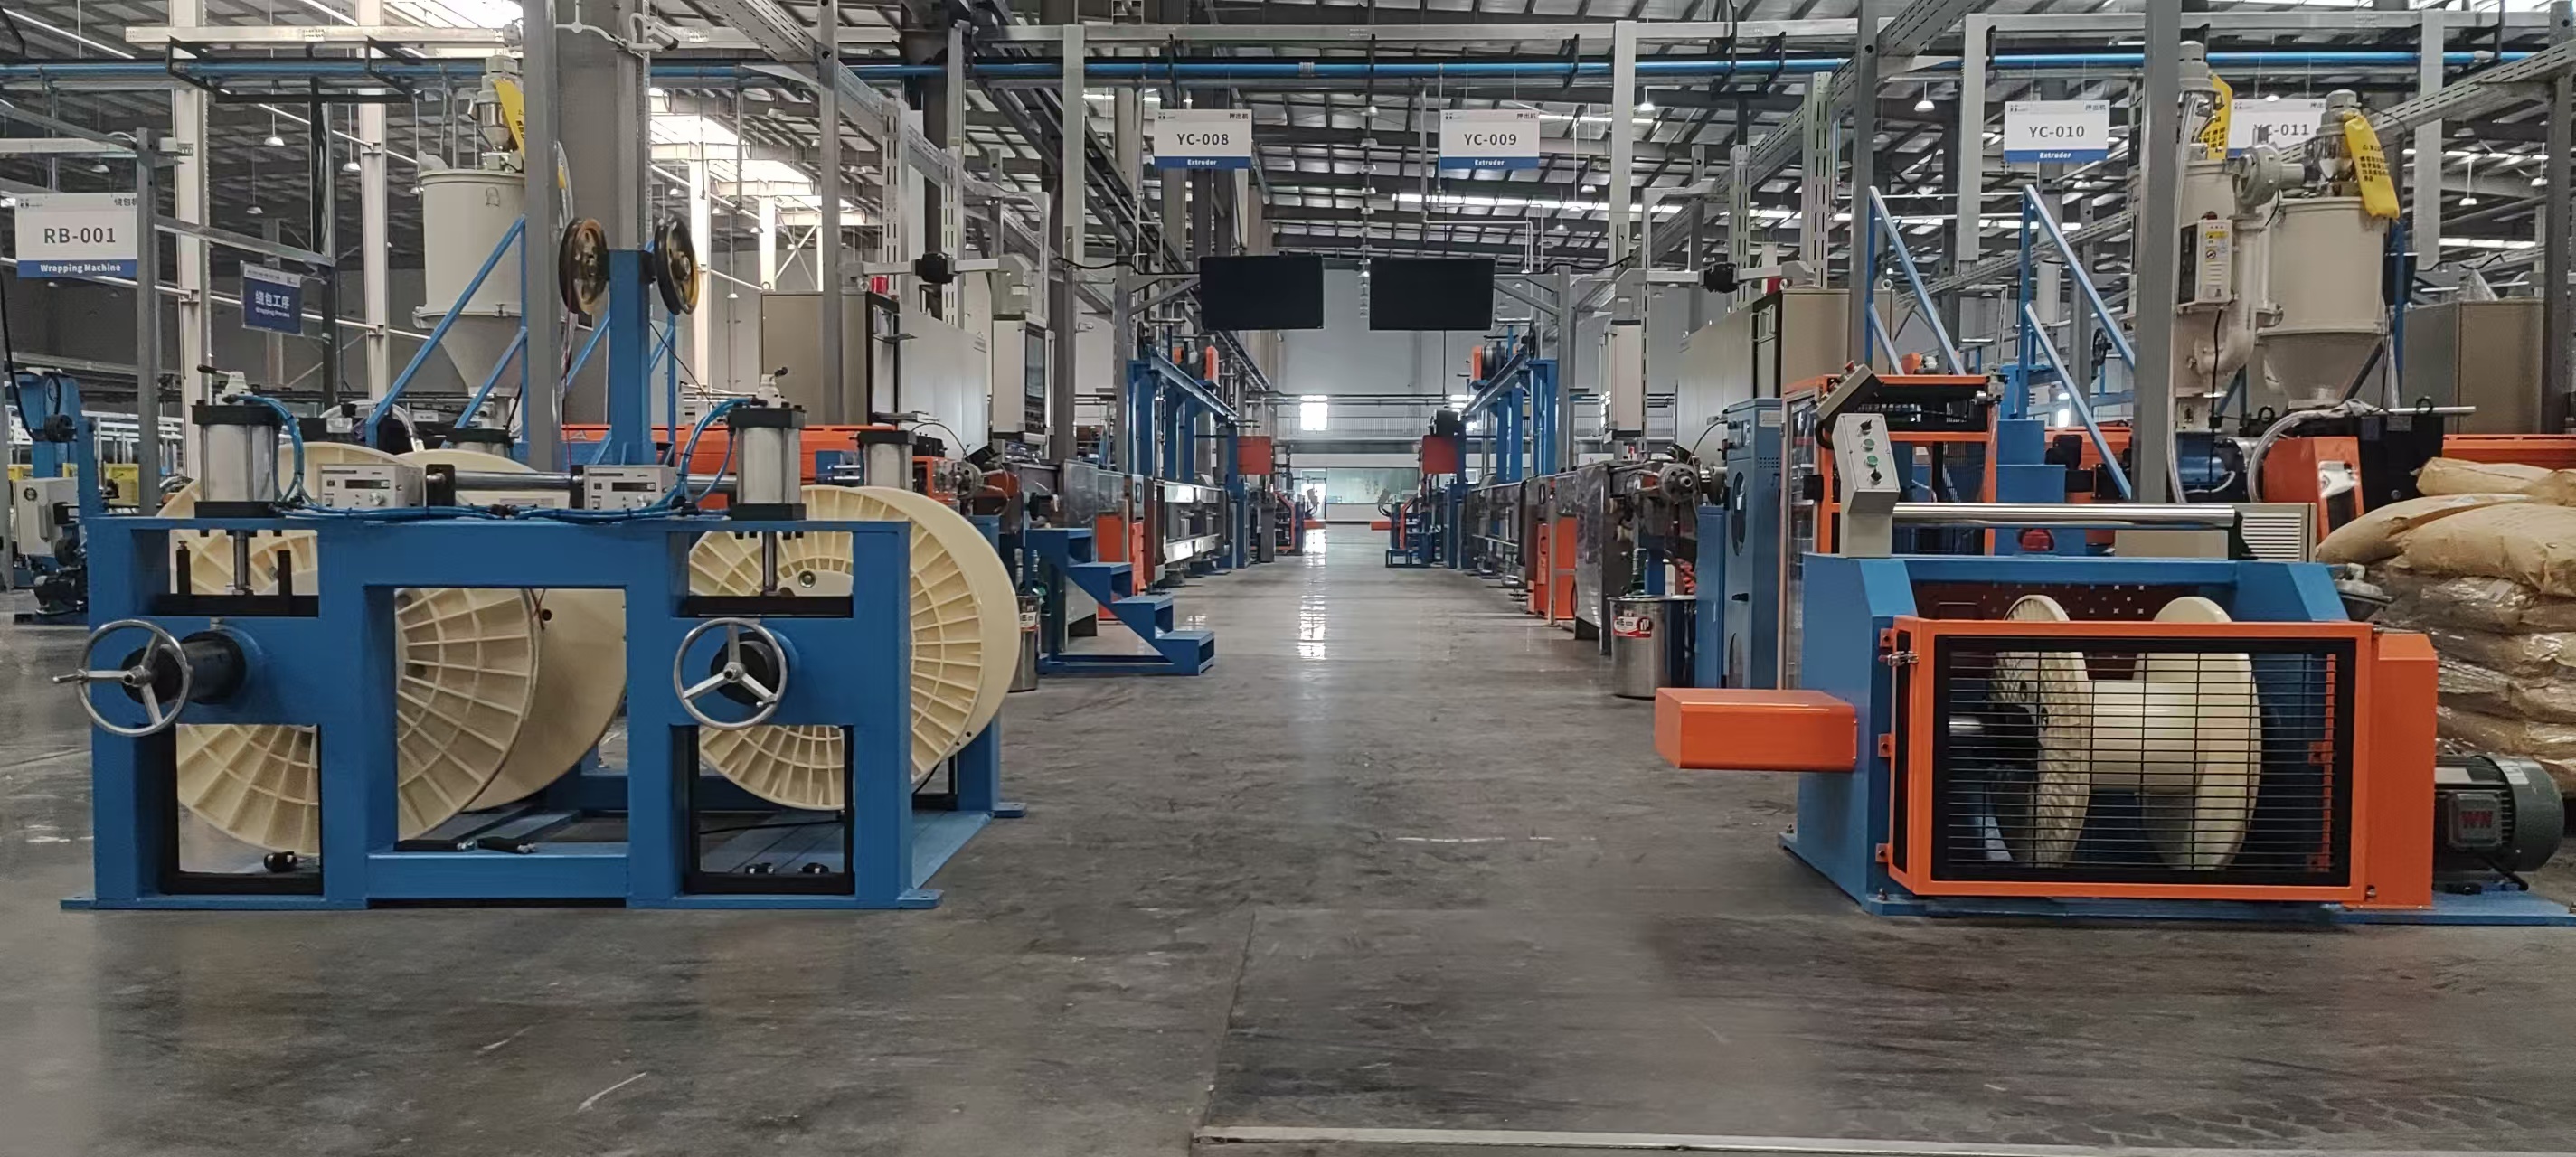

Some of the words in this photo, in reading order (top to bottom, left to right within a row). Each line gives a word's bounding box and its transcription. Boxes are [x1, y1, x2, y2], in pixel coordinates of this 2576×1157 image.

[2029, 126, 2085, 137] YC-010
[2253, 124, 2309, 136] -011
[1176, 133, 1229, 145] YC-008
[1464, 134, 1517, 146] YC-009
[43, 227, 117, 244] RB-001
[40, 264, 83, 273] Wrapping
[84, 263, 122, 271] Machine
